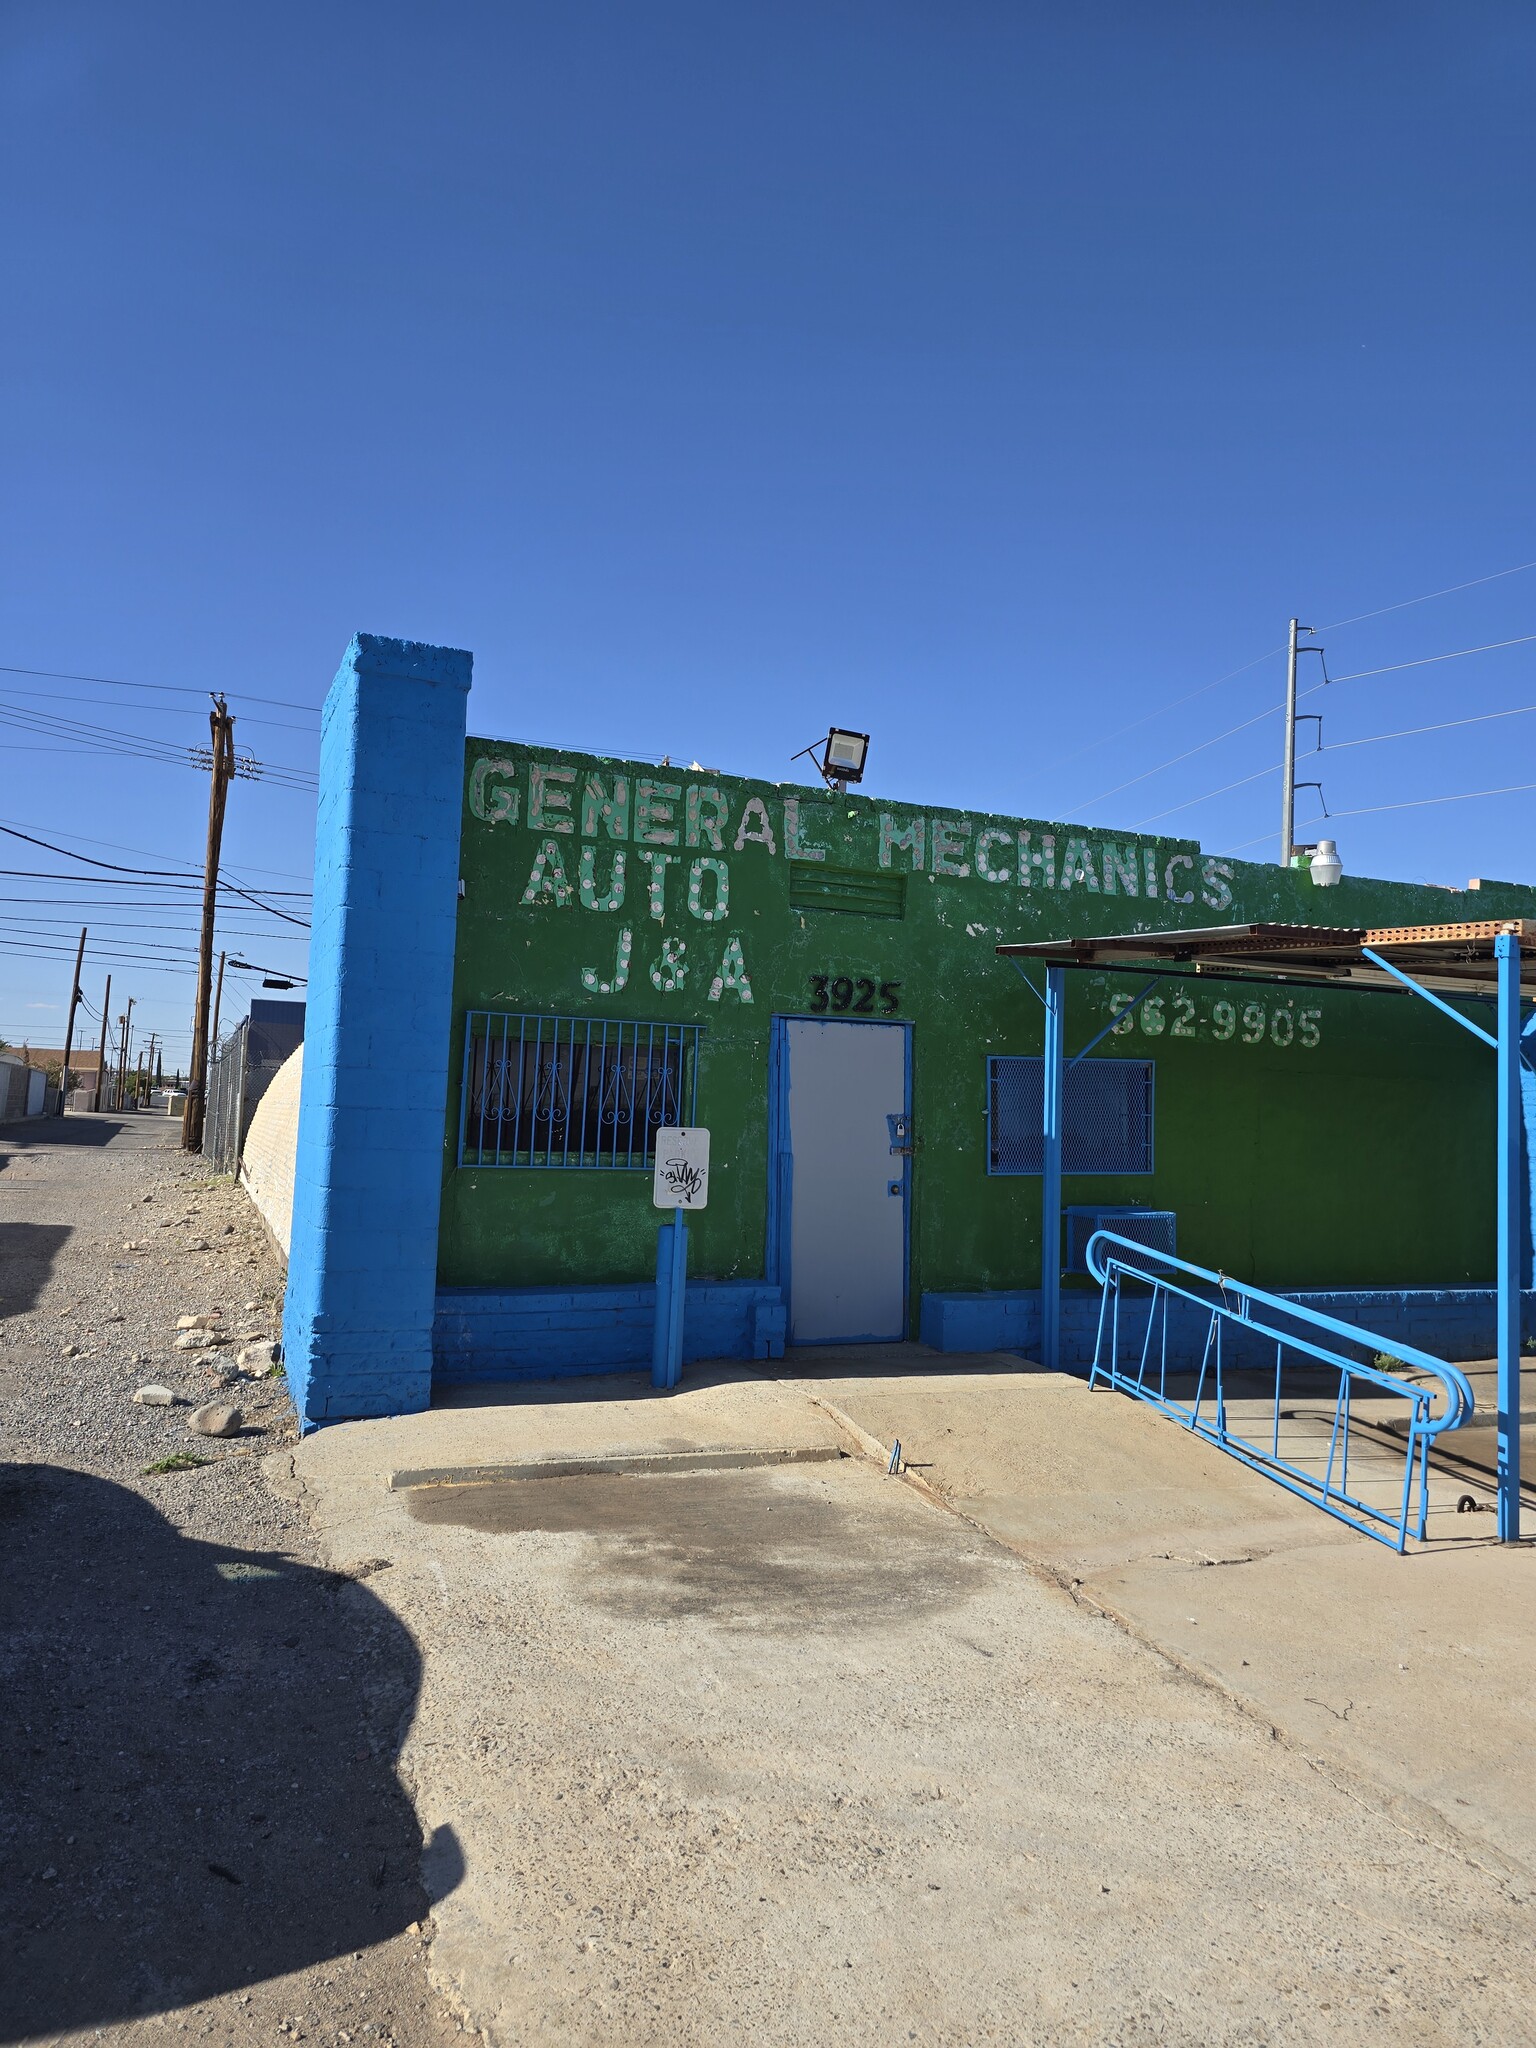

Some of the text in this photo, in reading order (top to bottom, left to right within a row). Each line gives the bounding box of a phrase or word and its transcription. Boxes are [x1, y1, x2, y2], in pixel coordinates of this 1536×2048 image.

[469, 757, 1235, 911] GENERAL MECHANICS
[519, 838, 729, 922] AUTO
[581, 927, 755, 1004] J & A
[809, 975, 902, 1014] 3925
